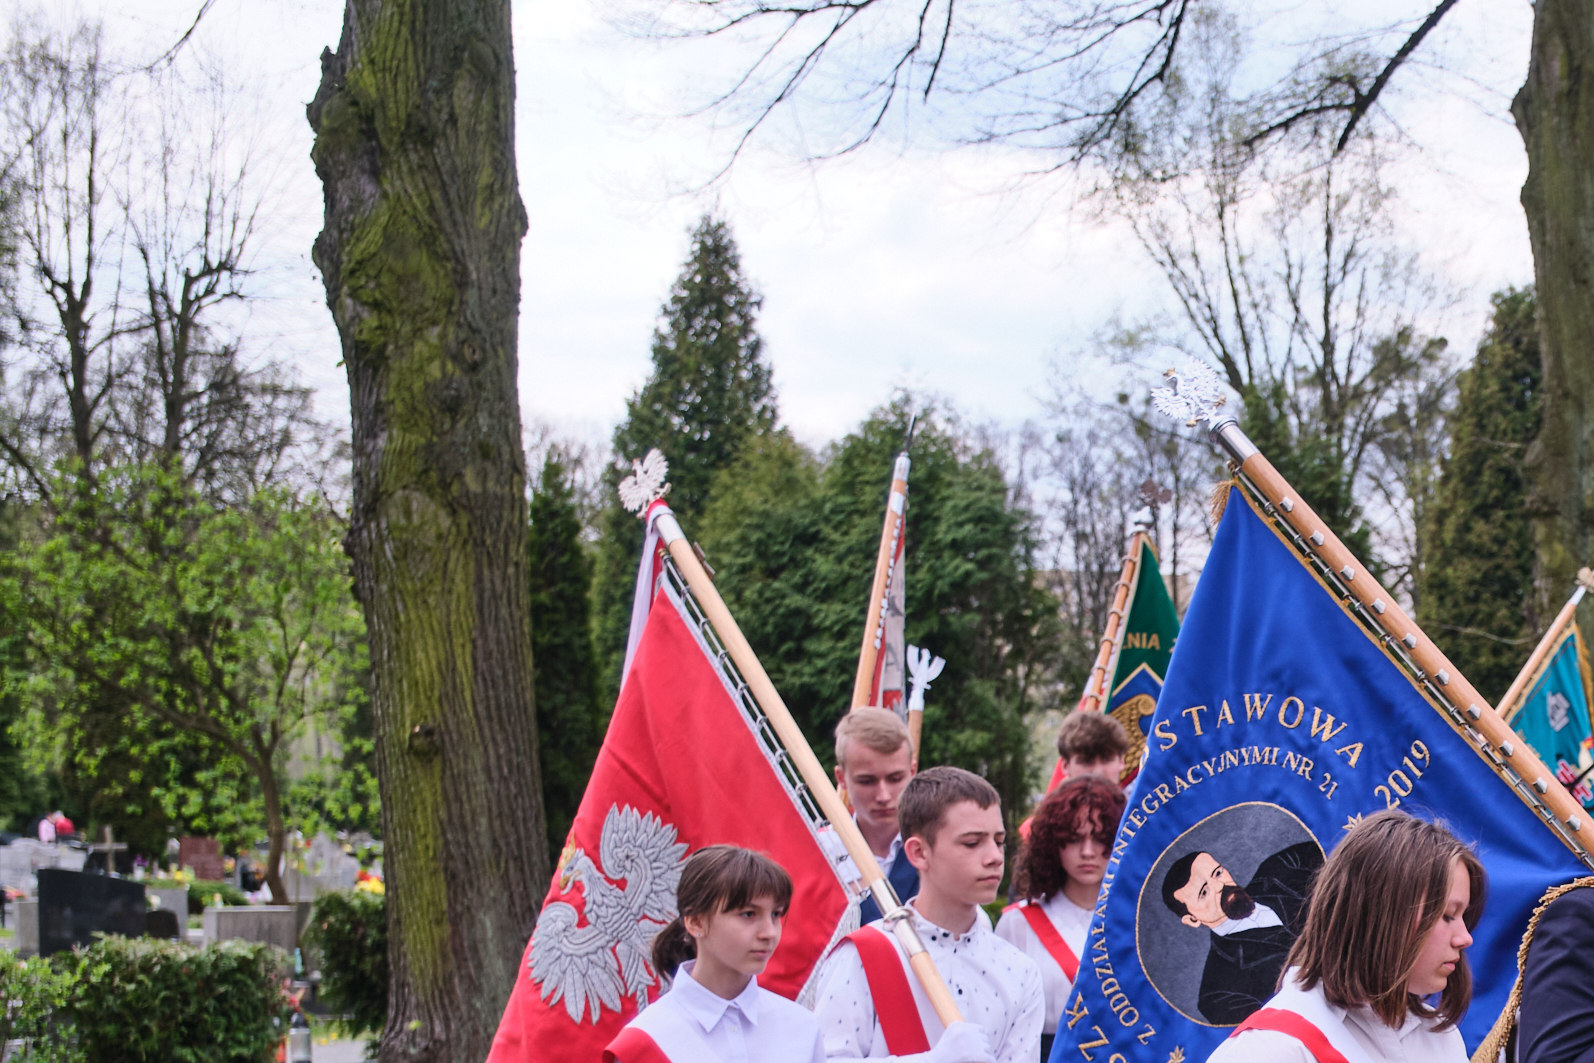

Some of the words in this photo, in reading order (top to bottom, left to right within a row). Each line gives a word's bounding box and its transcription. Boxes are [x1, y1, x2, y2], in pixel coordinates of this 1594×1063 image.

[1122, 632, 1160, 650] NIA
[1282, 750, 1314, 781] NR
[1374, 738, 1432, 811] 2019
[1318, 772, 1339, 800] 21
[1110, 745, 1279, 865] INTEGRACYJNYMI
[1091, 871, 1140, 1027] ODDZIAŁAMI
[1137, 1023, 1157, 1046] Z
